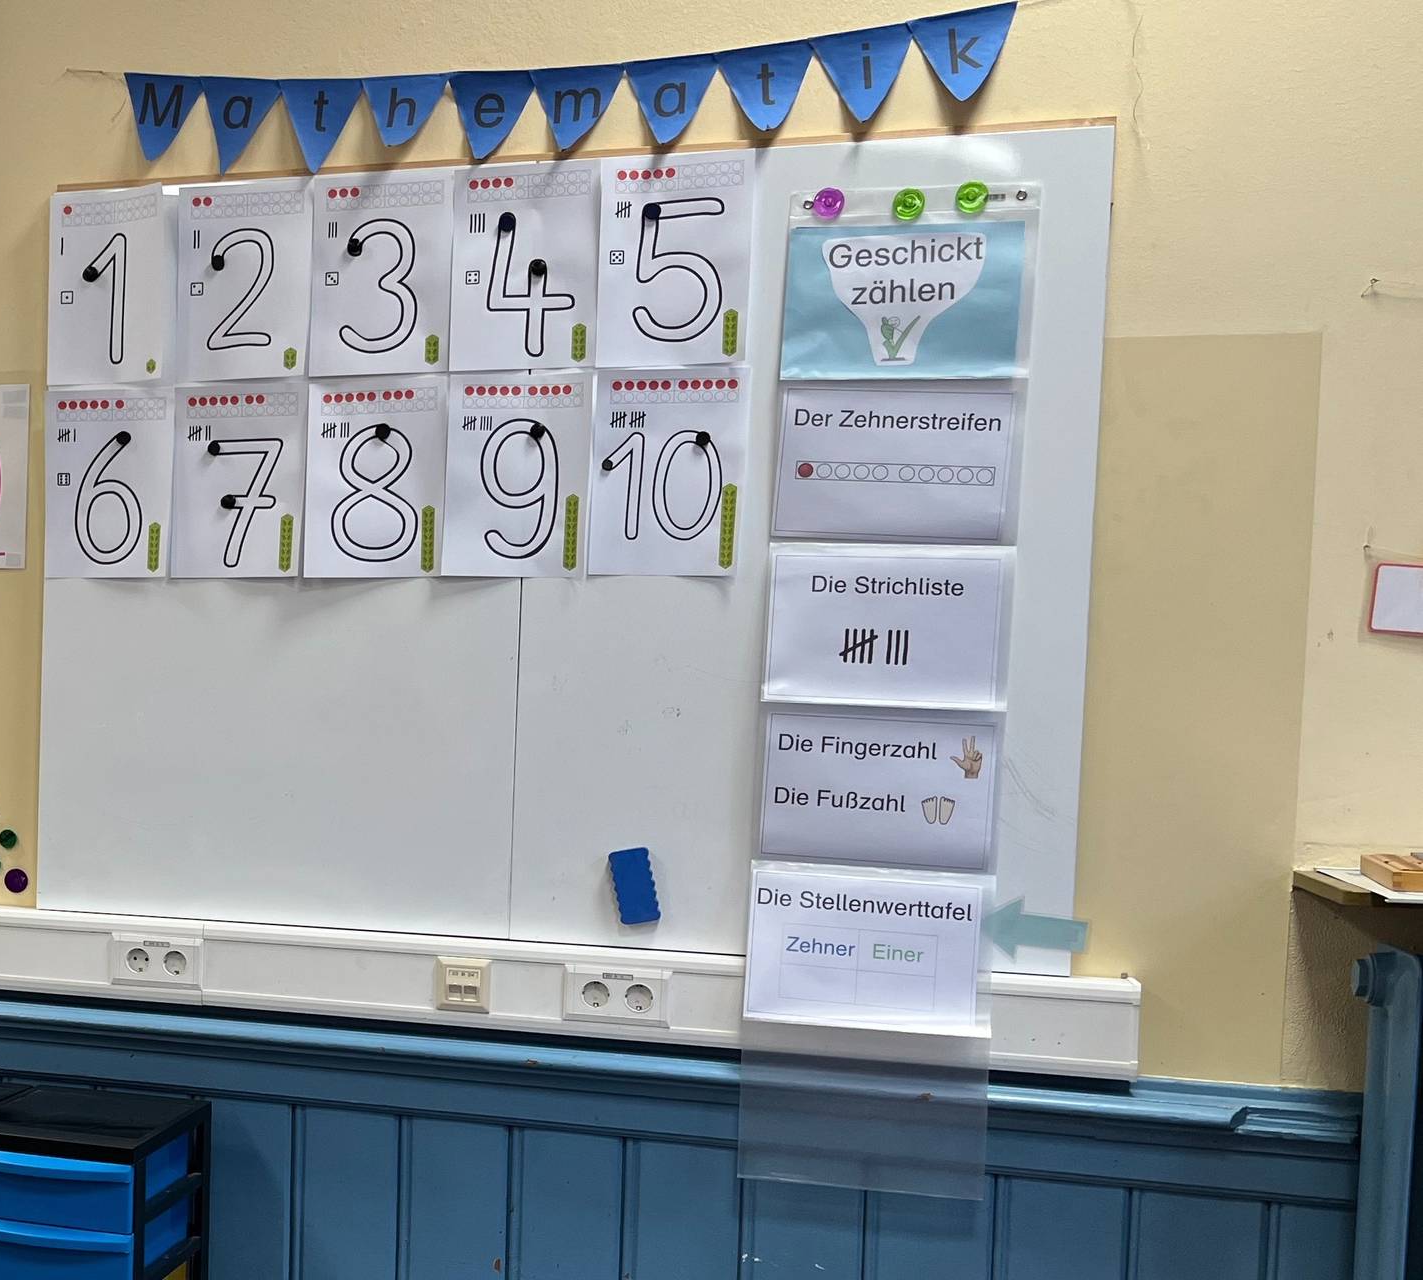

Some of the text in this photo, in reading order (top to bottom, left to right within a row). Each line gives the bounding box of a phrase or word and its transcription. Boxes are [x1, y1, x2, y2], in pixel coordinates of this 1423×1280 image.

[137, 28, 984, 131] Mathematik
[82, 232, 127, 365] 1
[206, 227, 275, 351] 2
[339, 218, 418, 354] 3
[485, 210, 576, 358] 4
[631, 196, 726, 343] 5
[827, 235, 985, 270] Geschickt
[849, 277, 957, 309] zählen
[794, 408, 1003, 433] Der Zehnerstreifen
[73, 429, 143, 566] 6
[206, 436, 284, 569] 7
[330, 422, 419, 564] 8
[479, 417, 559, 559] 9
[601, 428, 724, 542] 10
[811, 575, 965, 597] Die Strichliste
[774, 786, 906, 814] Die Fußzahl
[778, 733, 938, 762] Die Fingerzahl
[757, 887, 973, 923] Die Stellenwerttafel
[785, 935, 856, 959] Zehner
[871, 941, 925, 964] Einer
